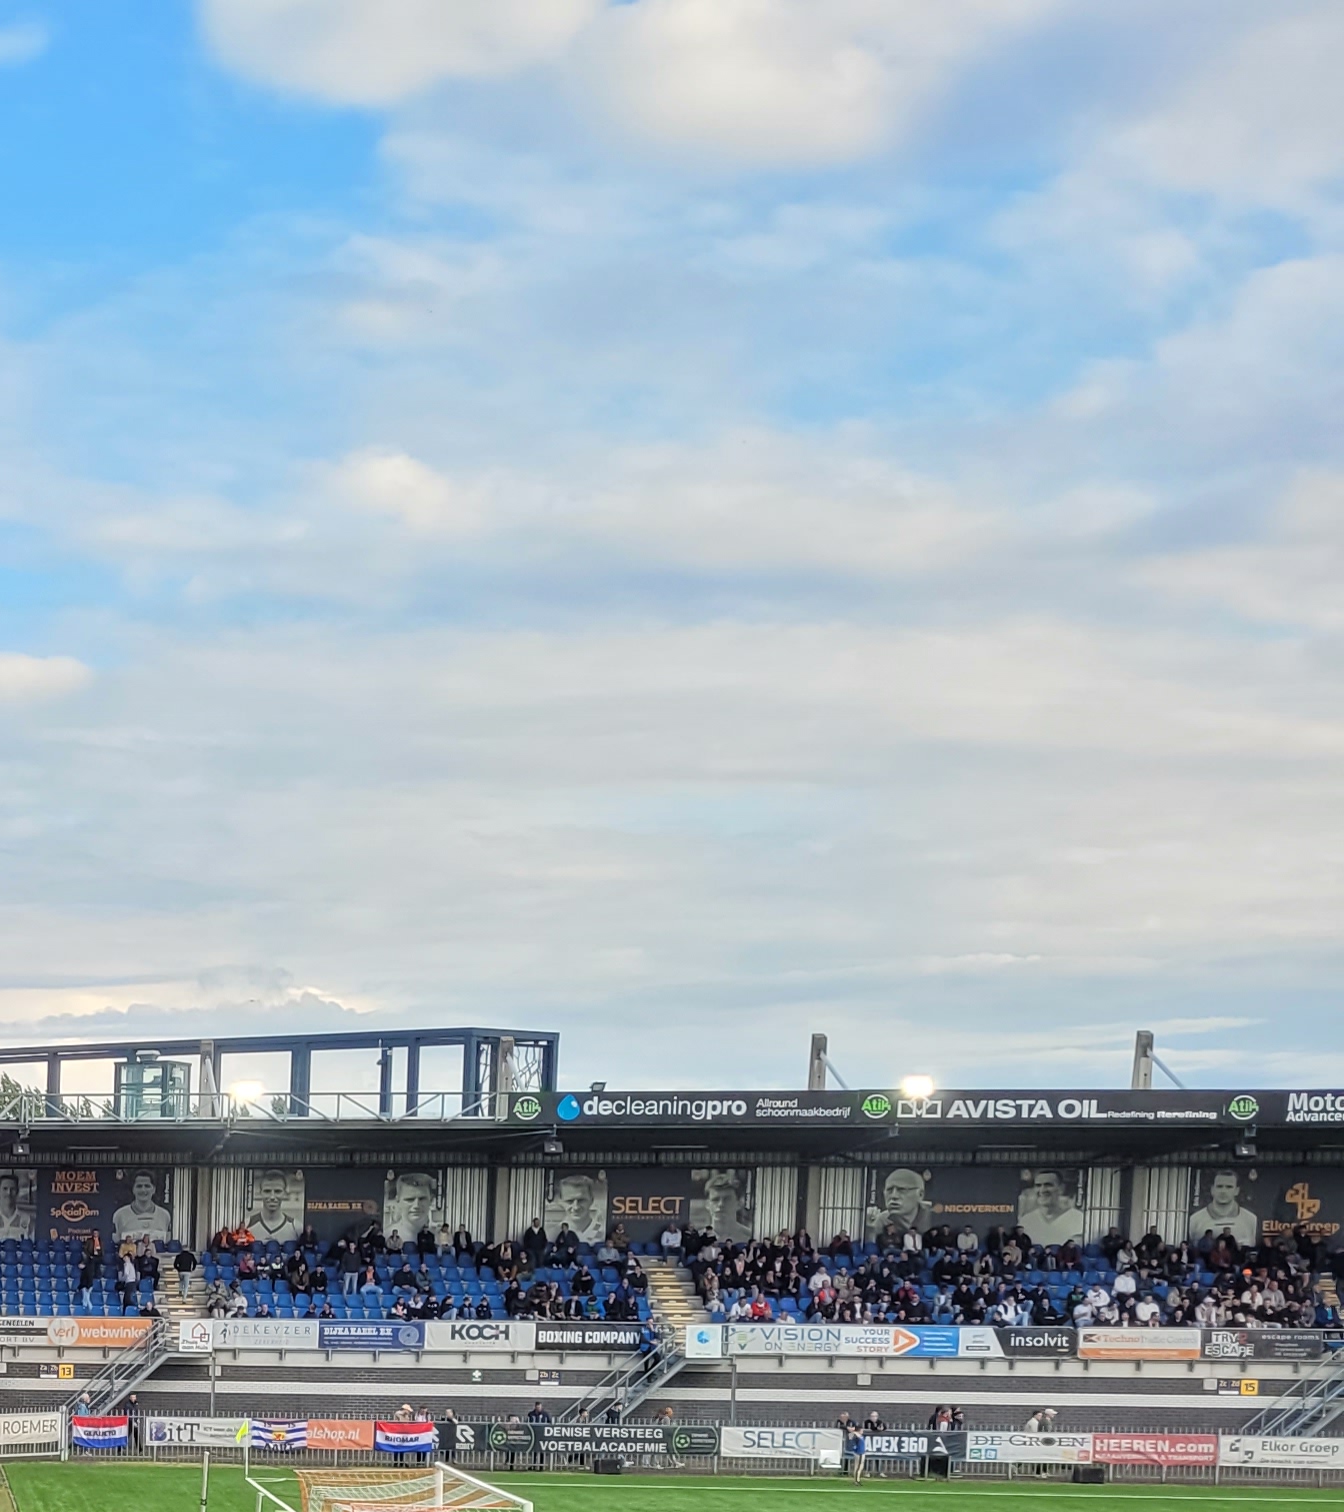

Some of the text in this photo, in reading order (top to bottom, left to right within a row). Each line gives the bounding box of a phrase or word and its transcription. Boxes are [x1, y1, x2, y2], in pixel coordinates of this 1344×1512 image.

[583, 1095, 747, 1120] decleaningpro
[756, 1098, 798, 1108] Allround
[946, 1099, 1053, 1119] AVISTA
[1058, 1099, 1108, 1119] OIL
[1107, 1110, 1154, 1119] Redefining
[755, 1107, 851, 1118] schoonmaakbedrijf
[55, 1170, 96, 1182] MOEM
[51, 1182, 100, 1194] INVEST
[612, 1196, 685, 1215] SELECT
[944, 1204, 1014, 1213] NICOVERKEN
[450, 1324, 510, 1341] KOCH
[538, 1330, 641, 1345] BOXING COMPANY
[762, 1328, 842, 1342] VISION
[863, 1328, 890, 1336] YOUR
[1102, 1333, 1140, 1343] Techno
[844, 1337, 890, 1345] SUCCESS
[1010, 1333, 1069, 1347] insolvit
[765, 1341, 841, 1352] ON ENERGY
[856, 1345, 890, 1353] STORY
[1204, 1344, 1255, 1357] ESCAPE
[61, 1367, 72, 1376] 13
[1244, 1383, 1255, 1392] 15
[2, 1419, 58, 1435] ROEMER
[544, 1426, 664, 1439] DENISE VERSTEEG
[743, 1430, 822, 1449] SELECT
[864, 1436, 928, 1453] APEX 360
[972, 1435, 1002, 1446] DE
[539, 1441, 667, 1453] VOETBALACADEMIE
[1094, 1438, 1215, 1454] HEEREN.com
[1261, 1440, 1340, 1456] Elkor Groep
